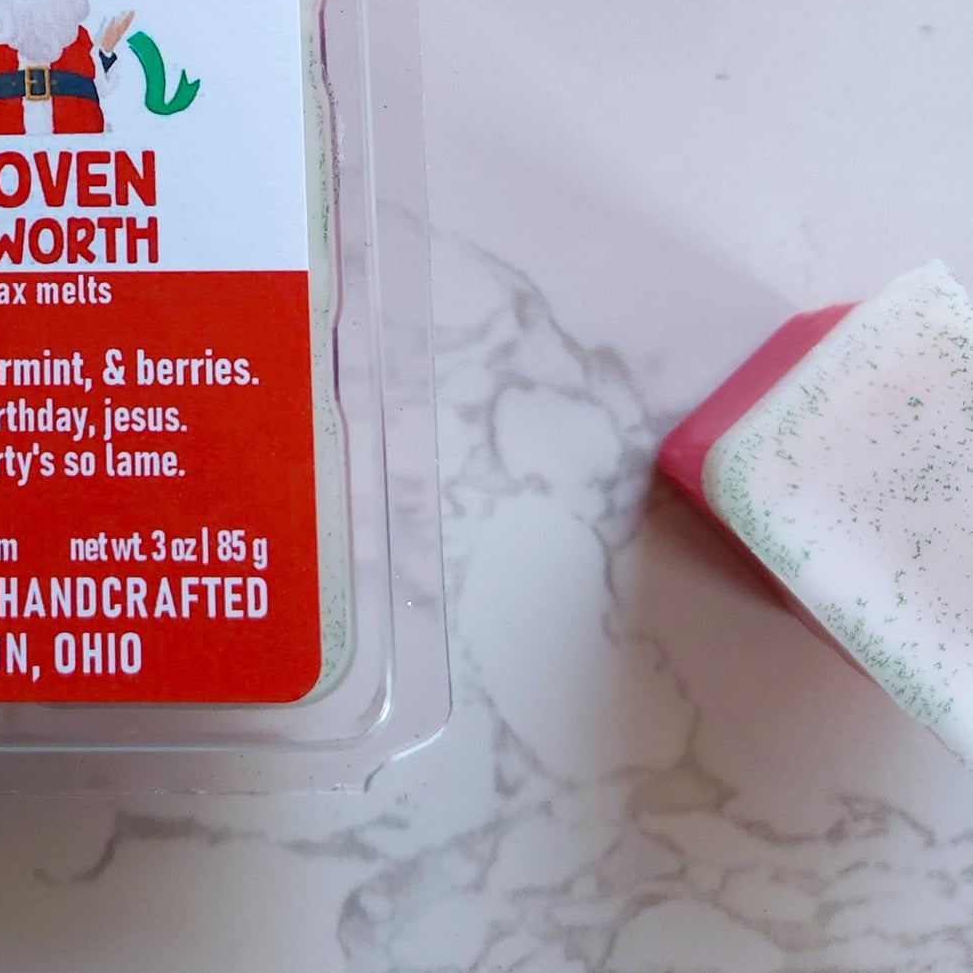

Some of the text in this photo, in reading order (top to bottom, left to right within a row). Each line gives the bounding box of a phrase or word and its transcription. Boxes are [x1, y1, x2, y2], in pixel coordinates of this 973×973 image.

[37, 275, 111, 304] melts
[103, 349, 125, 385] &
[137, 349, 259, 385] berries.
[104, 398, 187, 437] jesus.
[65, 452, 95, 476] so
[106, 443, 185, 476] lame.
[71, 533, 107, 560] net
[152, 530, 166, 561] 3
[172, 538, 197, 561] oz
[218, 530, 246, 561] 85
[253, 538, 267, 570] g
[0, 577, 267, 618] HANDCRAFTED
[55, 633, 141, 674] OHIO
